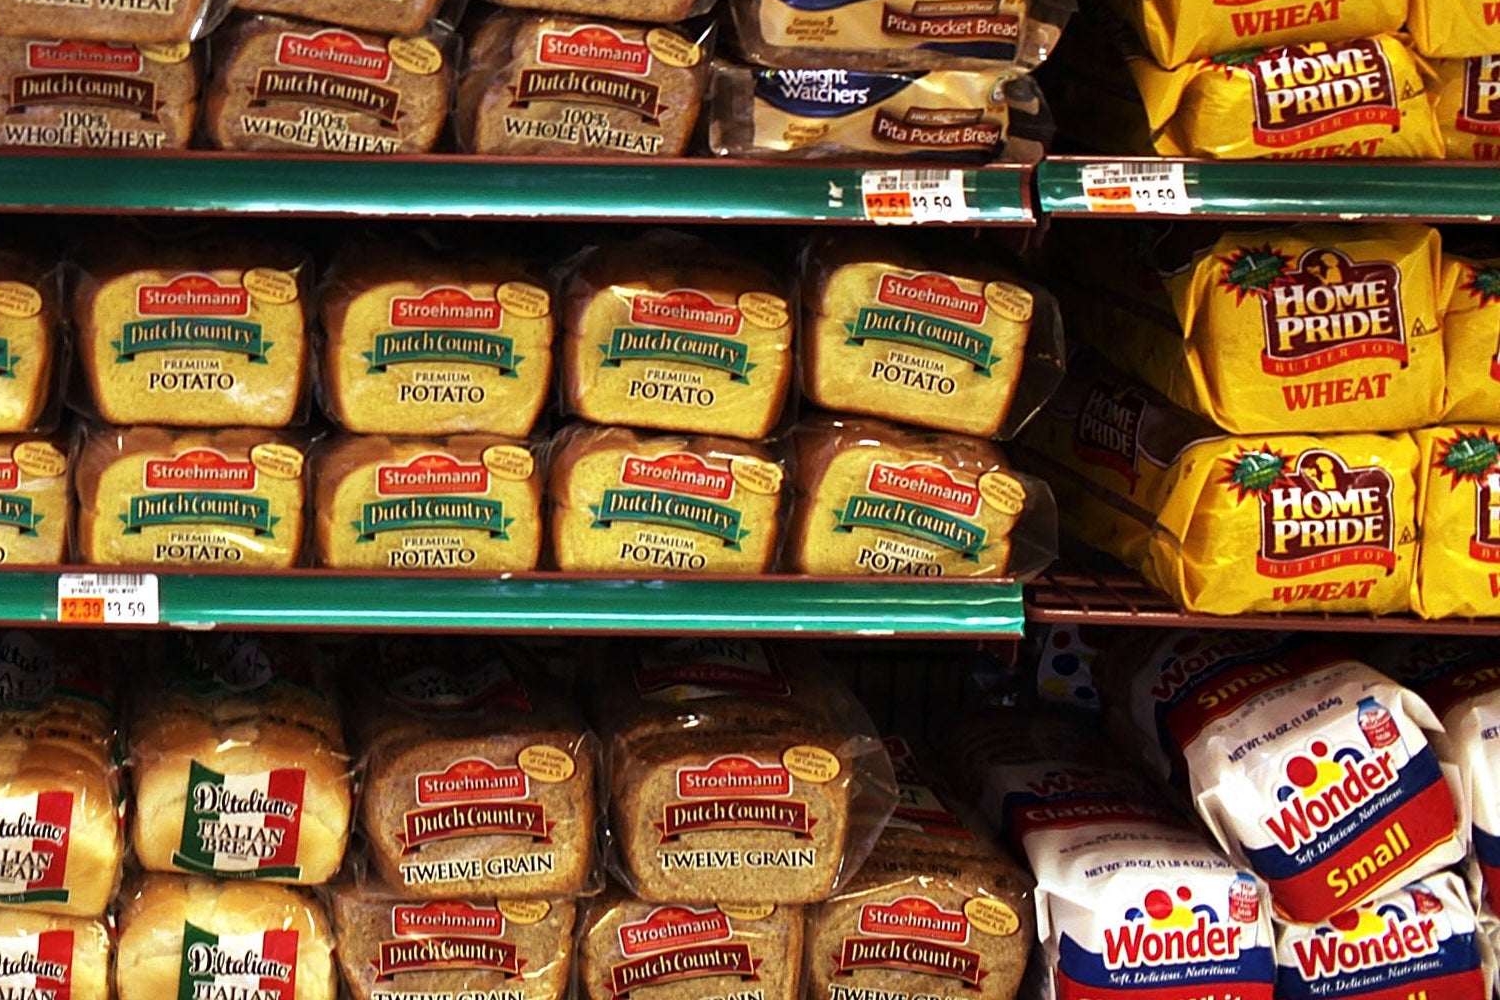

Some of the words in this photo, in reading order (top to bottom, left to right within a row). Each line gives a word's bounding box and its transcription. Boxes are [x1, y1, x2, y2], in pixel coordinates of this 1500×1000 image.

[1272, 281, 1387, 315] HOME
[1277, 310, 1393, 348] PRIDE
[629, 380, 714, 405] POTATO
[1283, 373, 1391, 411] WHEAT
[1087, 390, 1136, 433] HOME
[1078, 410, 1133, 454] PRIDE
[107, 601, 145, 617] $3.59
[1199, 663, 1289, 708] Small
[686, 773, 784, 789] Stroehmann
[1266, 749, 1399, 853] Wonder
[661, 850, 742, 868] TWELVE
[745, 849, 816, 869] GRAIN
[1325, 825, 1412, 900] Small
[1104, 919, 1240, 966] Wonder
